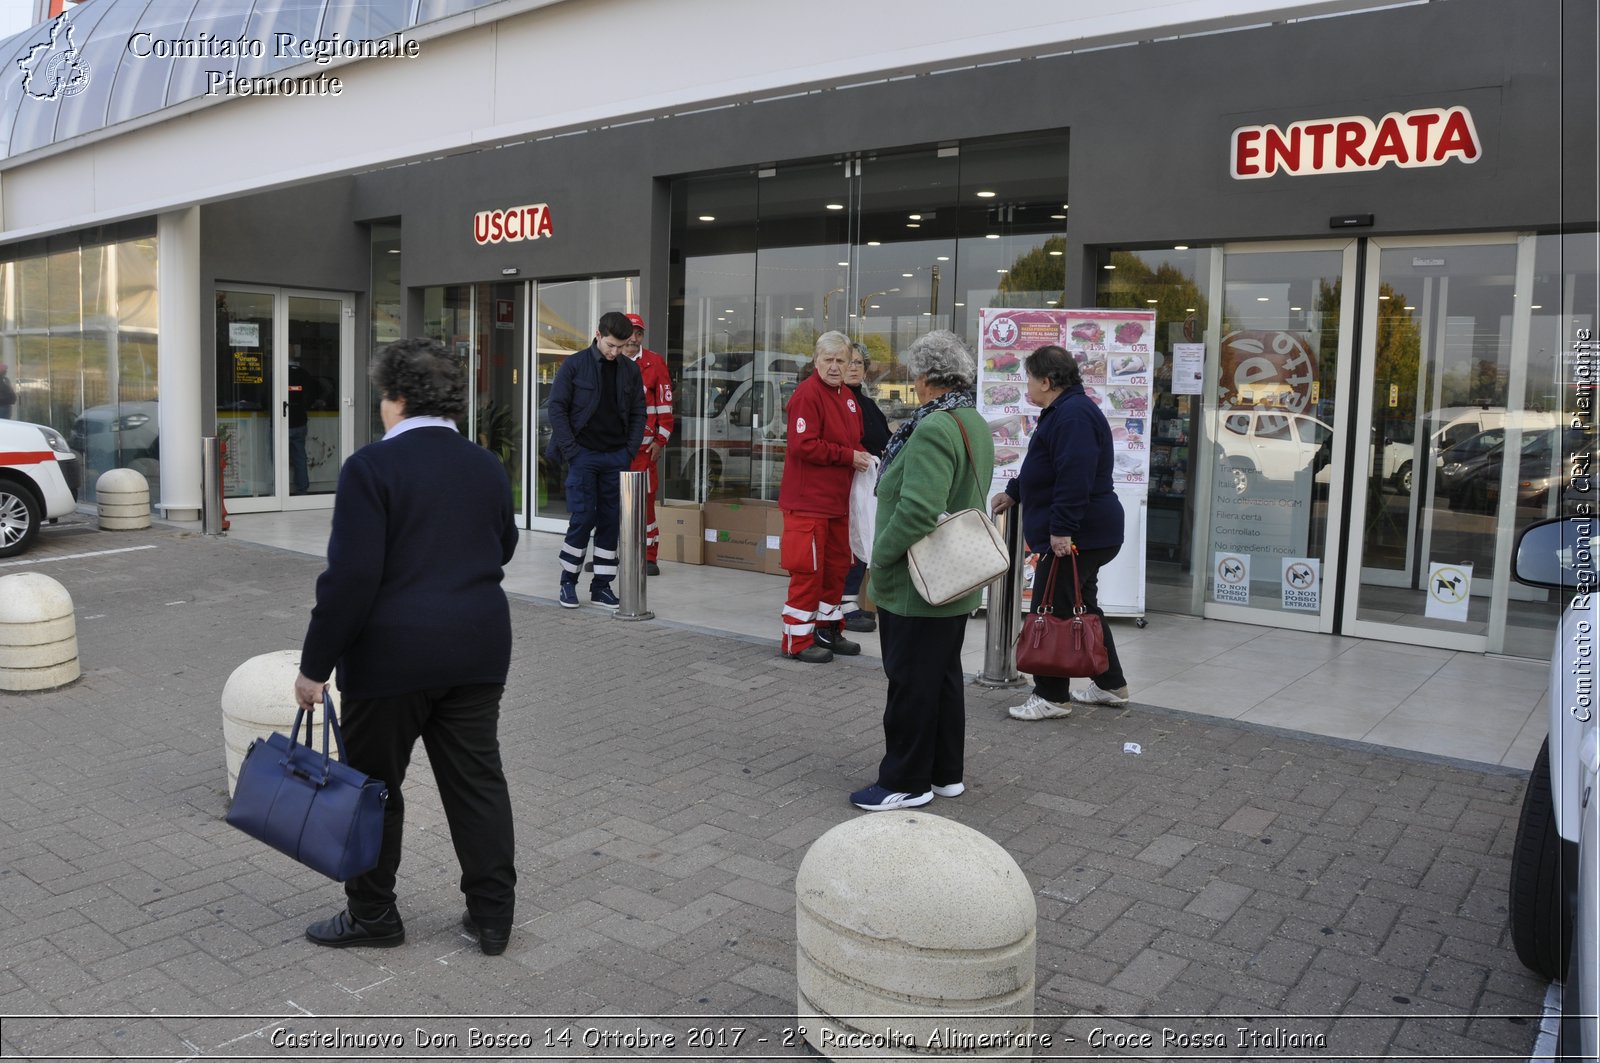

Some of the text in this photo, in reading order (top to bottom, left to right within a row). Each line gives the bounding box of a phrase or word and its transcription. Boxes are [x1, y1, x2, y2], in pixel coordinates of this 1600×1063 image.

[1235, 110, 1478, 176] ENTRATA
[475, 207, 553, 242] USCITA
[1217, 495, 1230, 504] No
[1278, 498, 1302, 508] OGM
[1216, 511, 1262, 521] Filiera certa
[1215, 526, 1261, 536] Controllato
[1214, 541, 1296, 555] No ingredienti nocivi
[1216, 594, 1247, 602] ENTRARE
